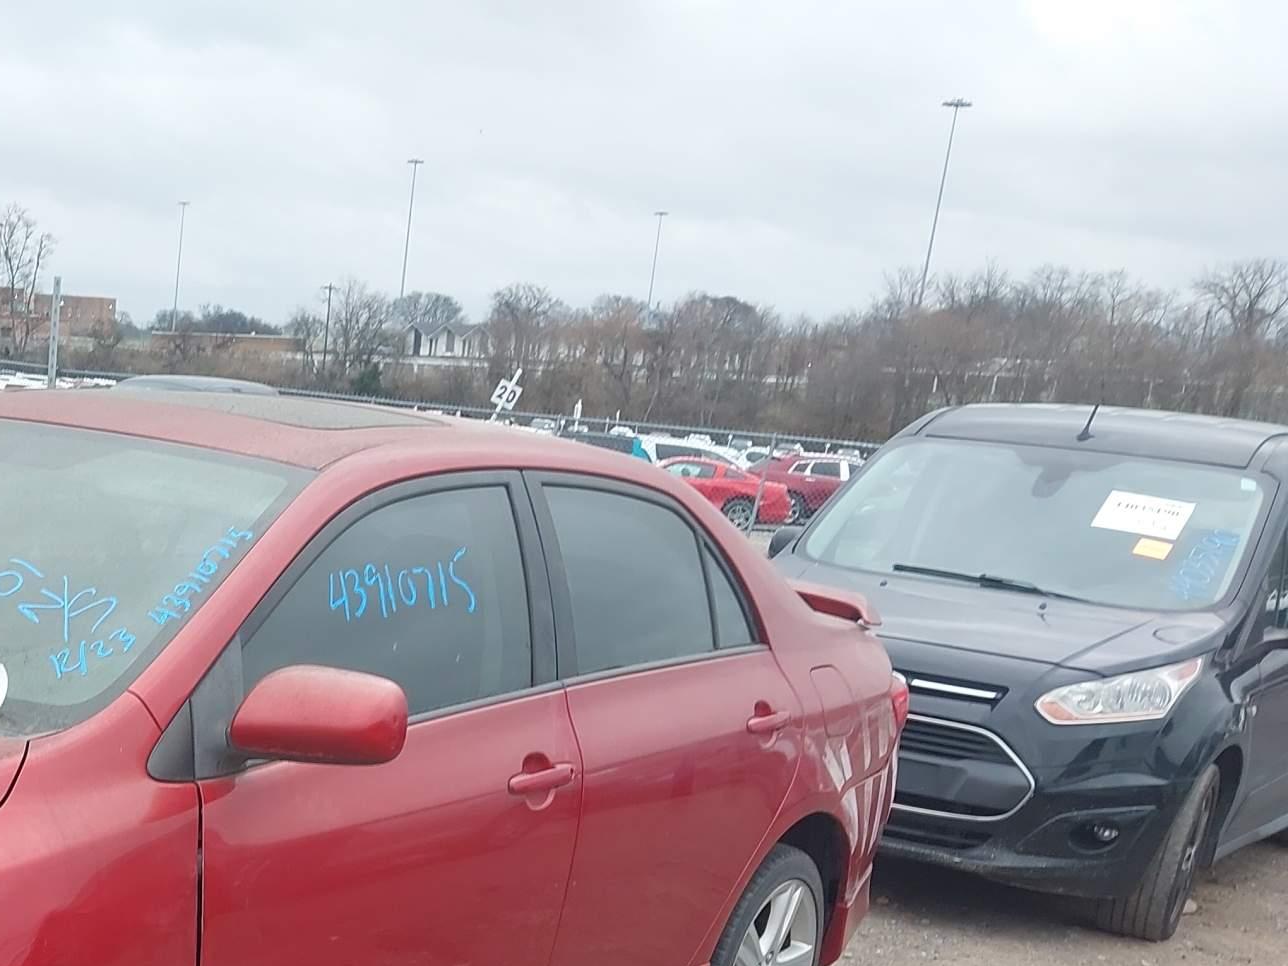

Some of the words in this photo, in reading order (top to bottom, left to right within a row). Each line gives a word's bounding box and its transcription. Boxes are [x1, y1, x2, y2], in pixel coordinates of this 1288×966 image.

[496, 385, 516, 403] 20
[148, 526, 254, 625] 43910715
[329, 547, 476, 622] 43910715
